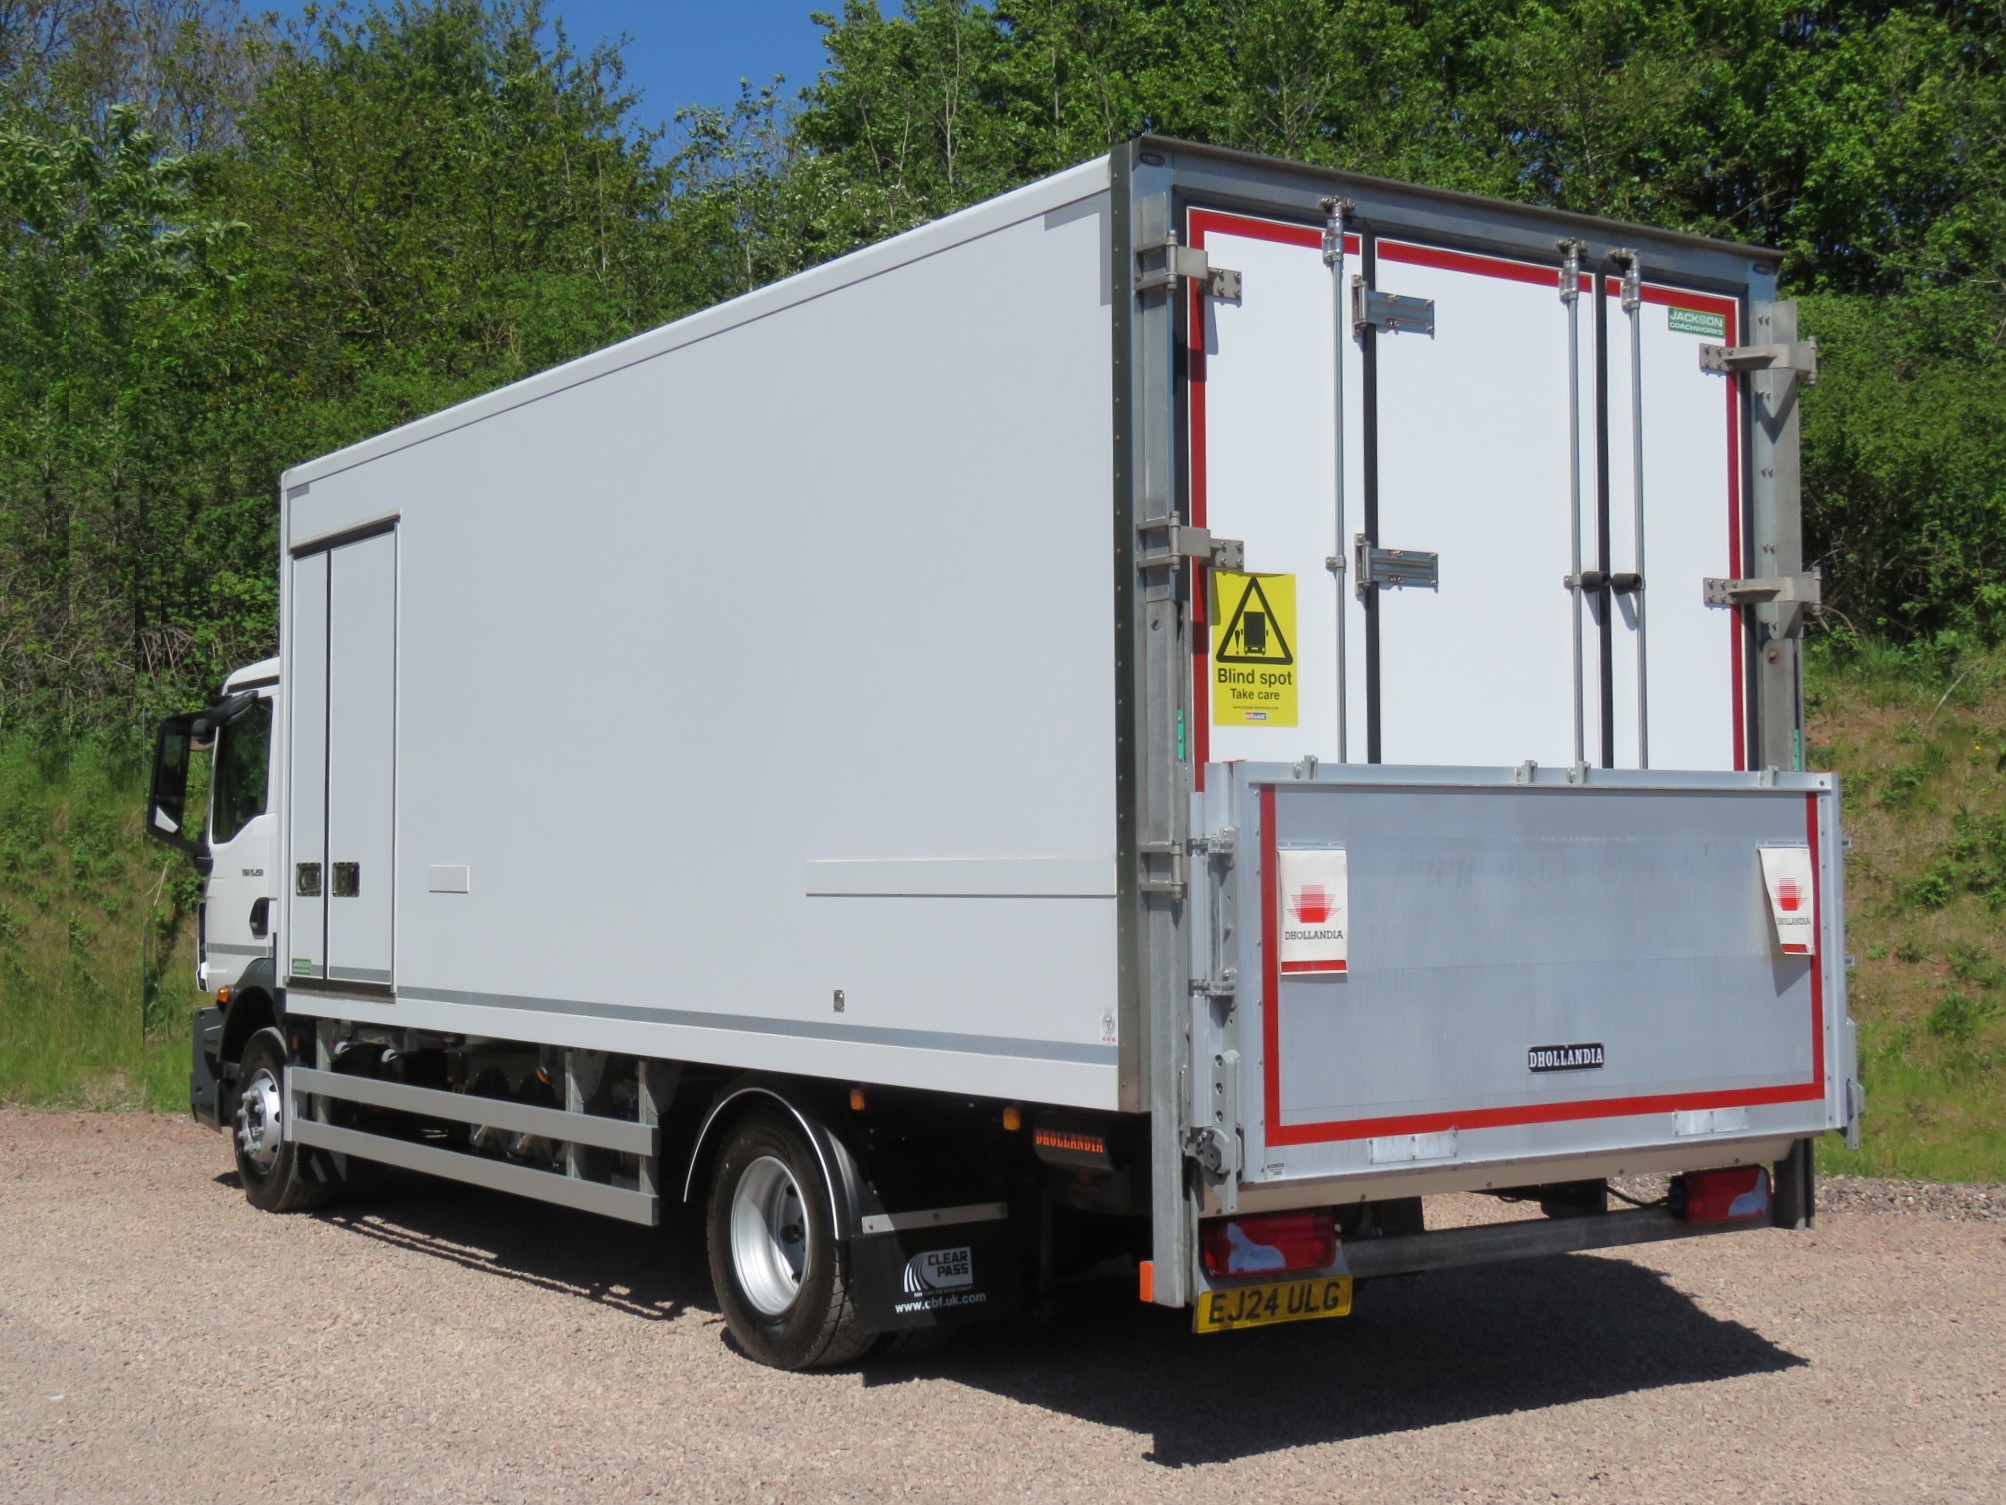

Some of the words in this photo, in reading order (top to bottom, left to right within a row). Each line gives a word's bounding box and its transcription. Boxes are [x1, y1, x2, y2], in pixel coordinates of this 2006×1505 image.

[1670, 310, 1723, 327] JACKSON
[1669, 322, 1724, 336] COACHWORKS
[1217, 667, 1255, 684] Blind
[1259, 670, 1292, 688] spot
[1230, 688, 1255, 700] Take
[1257, 690, 1280, 700] care
[1284, 930, 1344, 941] DHOLLANDIA
[1529, 1047, 1604, 1068] DHOLLANDIA
[1035, 1129, 1104, 1153] DHOLLANDIA
[927, 1250, 968, 1267] CLEAR
[937, 1262, 969, 1278] PASS
[894, 1292, 987, 1314] www.cbf.uk.com
[1209, 1286, 1280, 1324] EJ24
[1286, 1281, 1341, 1315] ULG
